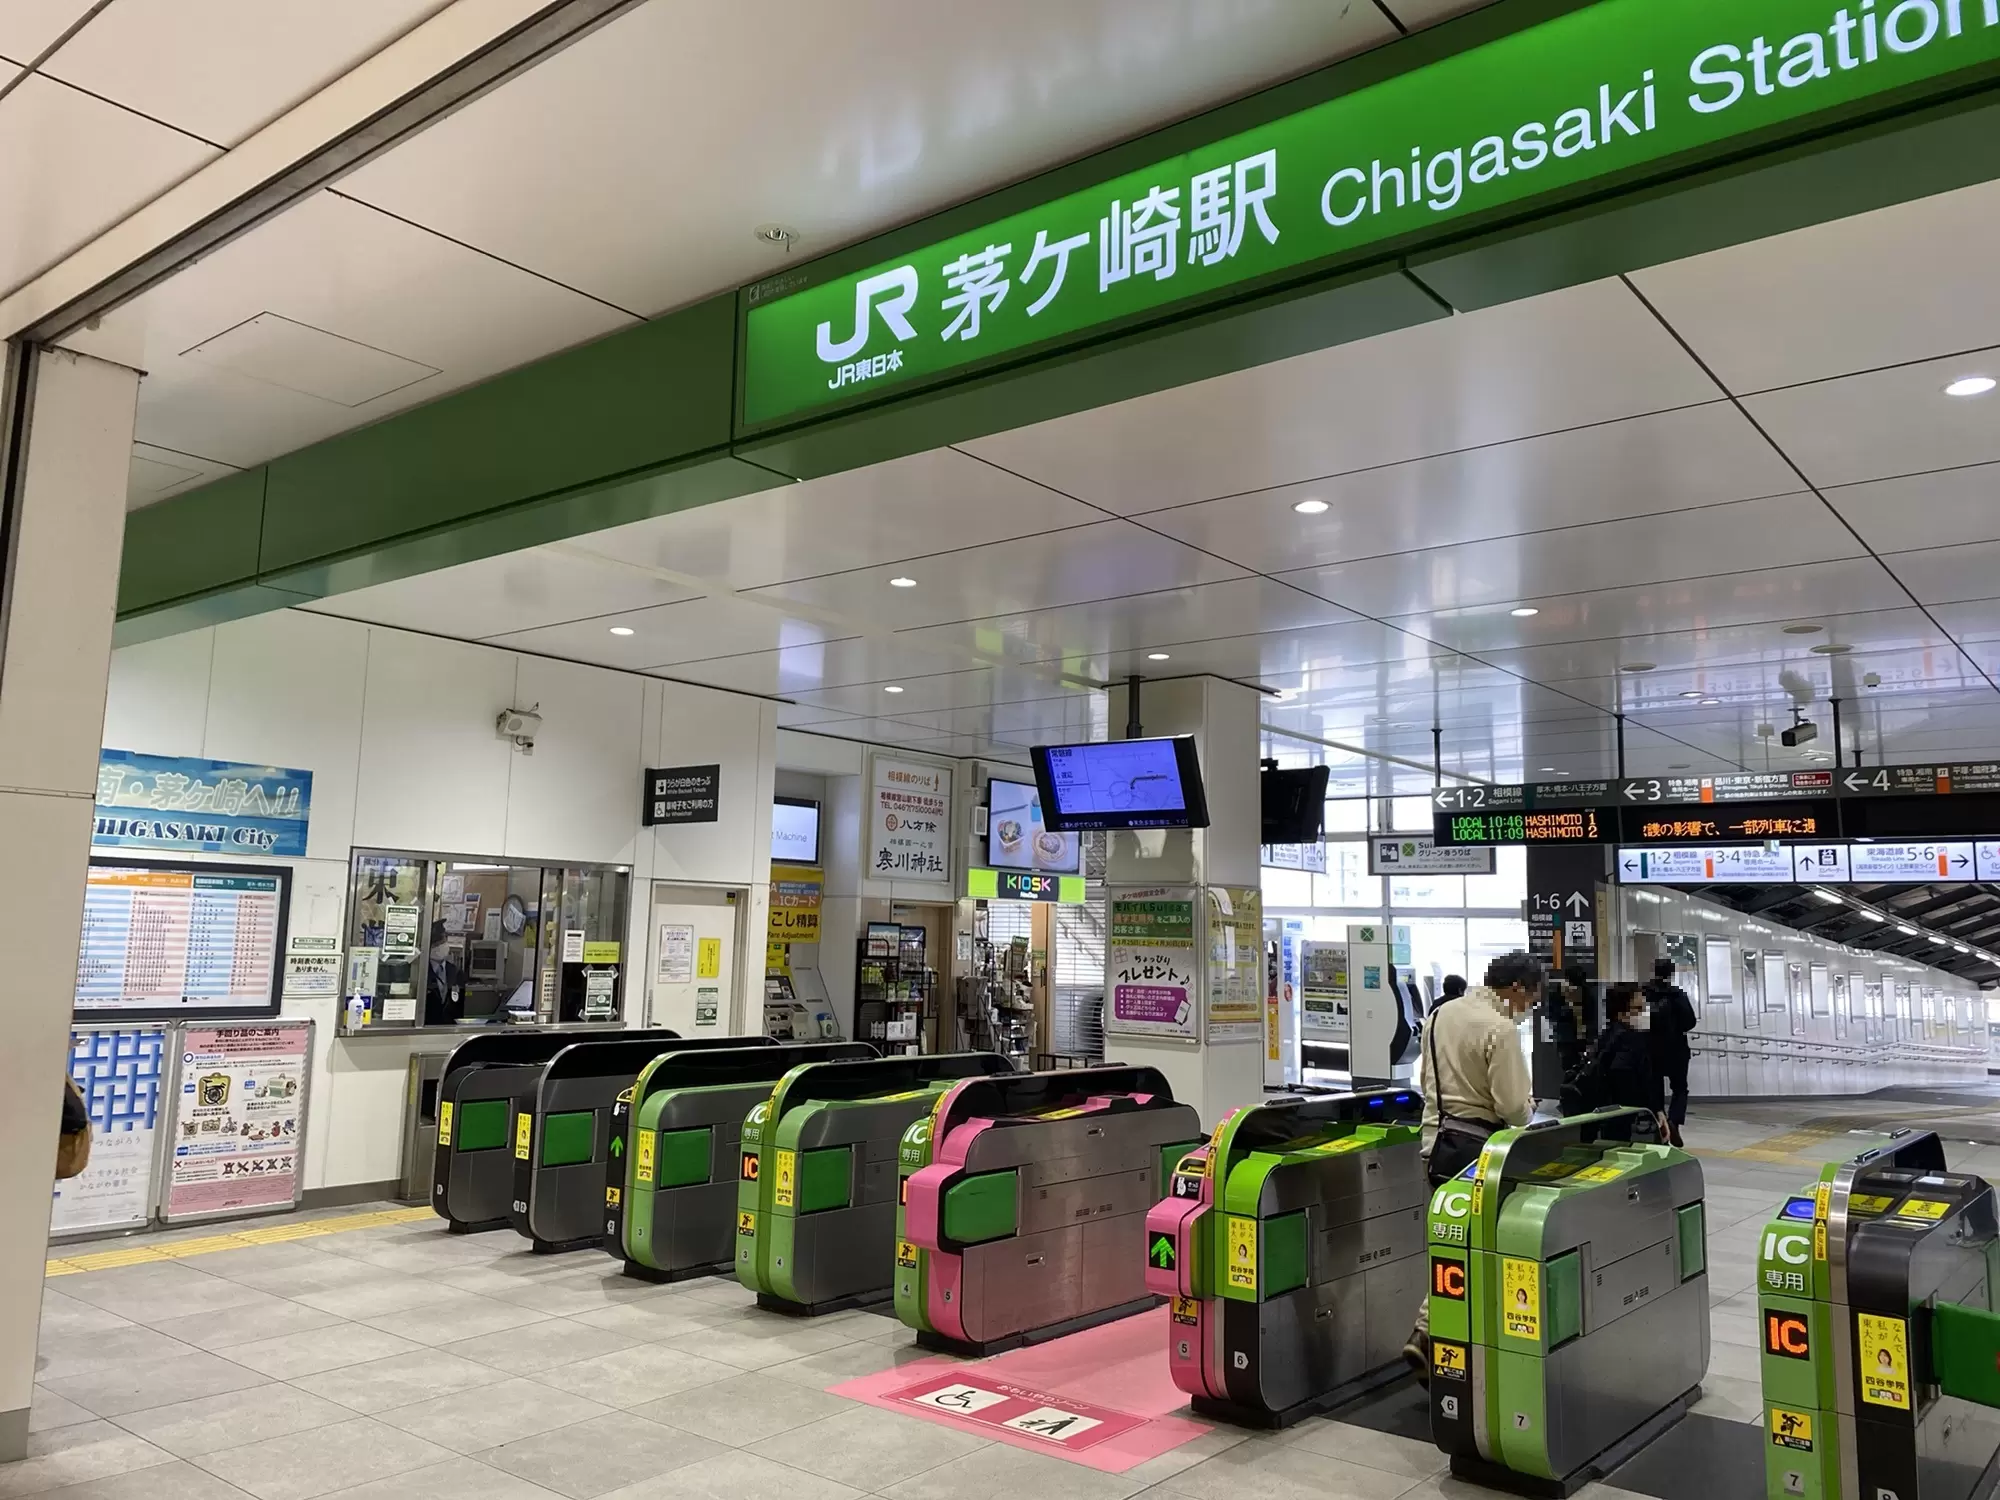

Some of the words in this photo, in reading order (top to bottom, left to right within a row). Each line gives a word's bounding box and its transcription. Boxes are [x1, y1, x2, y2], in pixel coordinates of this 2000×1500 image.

[1321, 69, 1656, 226] Chigasaki
[1688, 0, 2000, 114] Station
[816, 264, 919, 363] JR
[828, 350, 903, 389] JR東日本
[888, 770, 931, 787] 相模線のりば
[1872, 769, 1891, 791] 4
[1493, 787, 1522, 798] 相模線
[1648, 780, 1661, 800] 3
[899, 819, 937, 833] 八方除
[1452, 817, 1486, 829] LOCAL
[1489, 815, 1523, 828] 10:46
[1525, 814, 1582, 827] HASHIMOTO
[1588, 813, 1596, 826] 1
[233, 827, 278, 850] City
[776, 831, 808, 843] Machine
[1452, 829, 1487, 841] LOCAL
[1490, 827, 1524, 840] 11:09
[1525, 826, 1583, 839] HASHIMOTO
[1588, 826, 1597, 838] 2
[876, 847, 944, 874] 寒川神社
[1007, 874, 1051, 891] KIOSK
[780, 896, 816, 906] ICカード
[290, 957, 336, 965] 時刻表の配布は
[1118, 966, 1178, 983] プレゼント
[216, 1028, 280, 1038] 手回り品のご案内
[746, 1105, 767, 1125] IC
[744, 1128, 760, 1141] 専用
[904, 1124, 928, 1145] IC
[902, 1149, 920, 1163] 専用
[744, 1157, 759, 1178] IC
[1432, 1190, 1471, 1218] IC
[1432, 1222, 1464, 1241] 専用
[1764, 1232, 1811, 1264] IC
[743, 1250, 748, 1259] 3
[777, 1258, 782, 1266] 4
[1436, 1264, 1464, 1296] IC
[1765, 1269, 1804, 1292] 専用
[903, 1284, 909, 1293] 4
[946, 1291, 951, 1300] 5
[1506, 1312, 1537, 1324] 四谷学院
[1769, 1317, 1807, 1354] IC
[1182, 1343, 1187, 1353] 5
[1237, 1356, 1243, 1365] 6
[1865, 1376, 1905, 1390] 四谷学院
[996, 1385, 1090, 1410] おもいやりゾーン
[1447, 1400, 1454, 1411] 6
[1517, 1415, 1525, 1426] 7
[1790, 1473, 1799, 1486] 7
